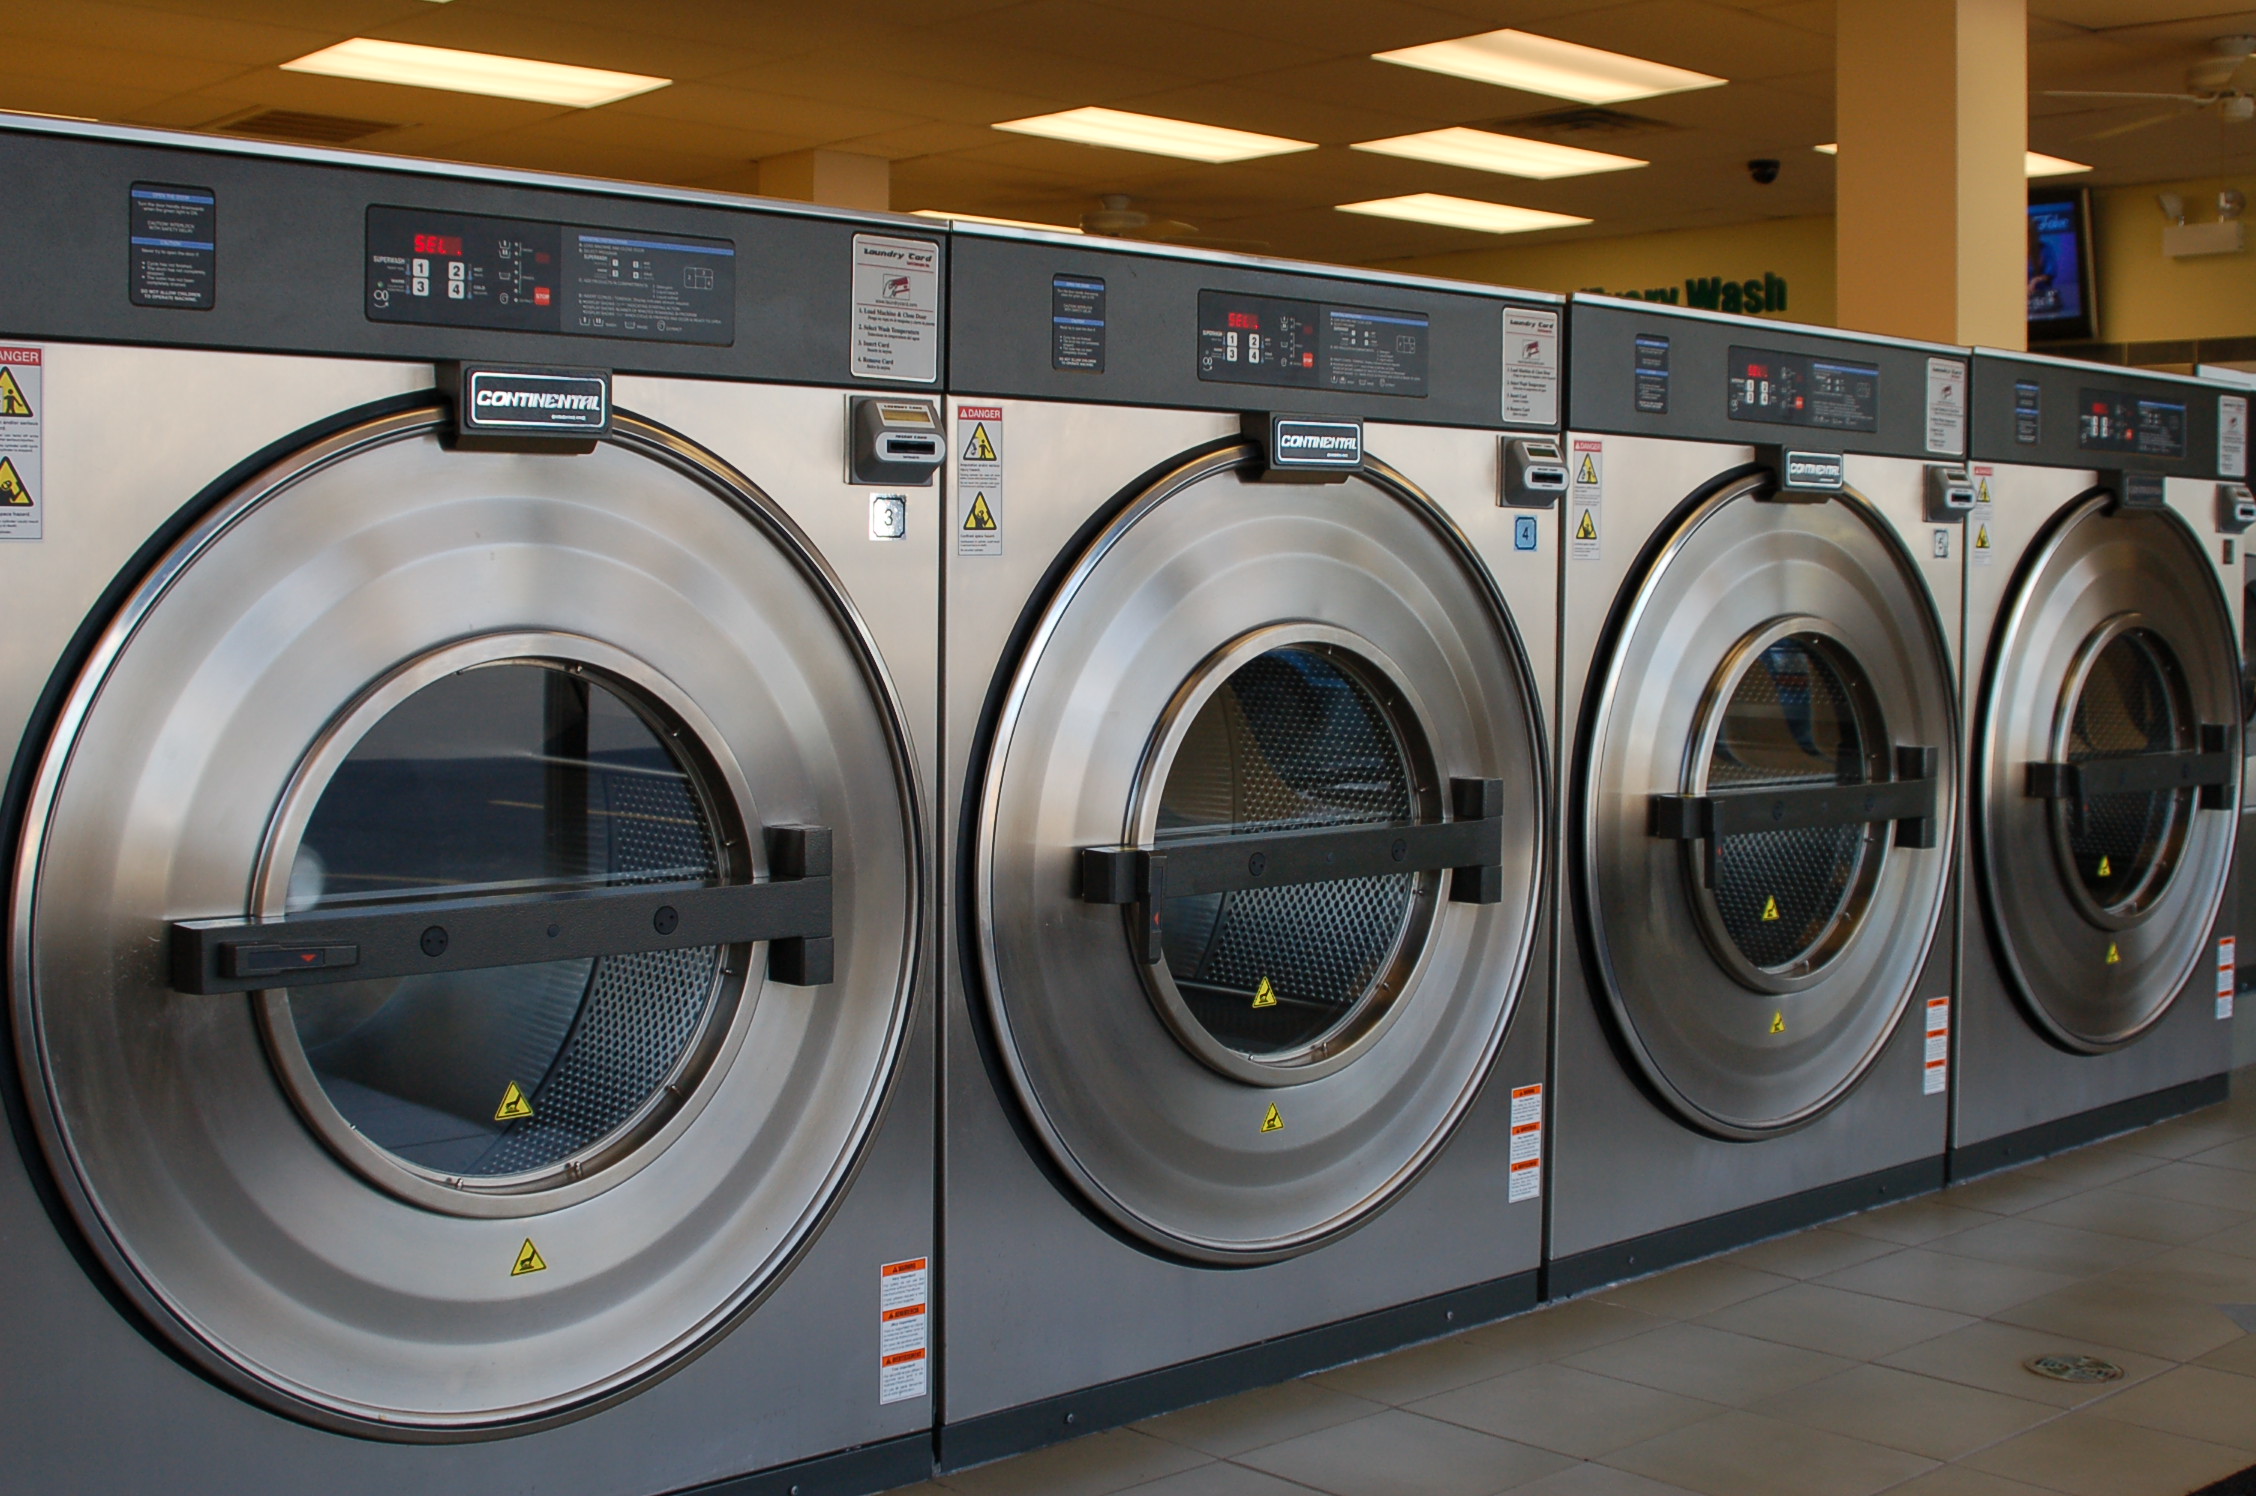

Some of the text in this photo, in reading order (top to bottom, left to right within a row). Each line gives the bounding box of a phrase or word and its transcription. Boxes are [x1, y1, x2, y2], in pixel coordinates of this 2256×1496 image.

[863, 248, 933, 263] Laundry Card
[418, 263, 424, 274] 1
[453, 265, 460, 277] 2
[418, 281, 425, 292] 3
[453, 284, 460, 296] 4
[1685, 271, 1788, 315] Wash
[476, 389, 601, 411] CONTINENTAL
[968, 409, 1001, 419] DANGER
[1280, 434, 1358, 451] CONTINENTAL
[884, 508, 894, 526] 3
[1522, 526, 1529, 541] 4
